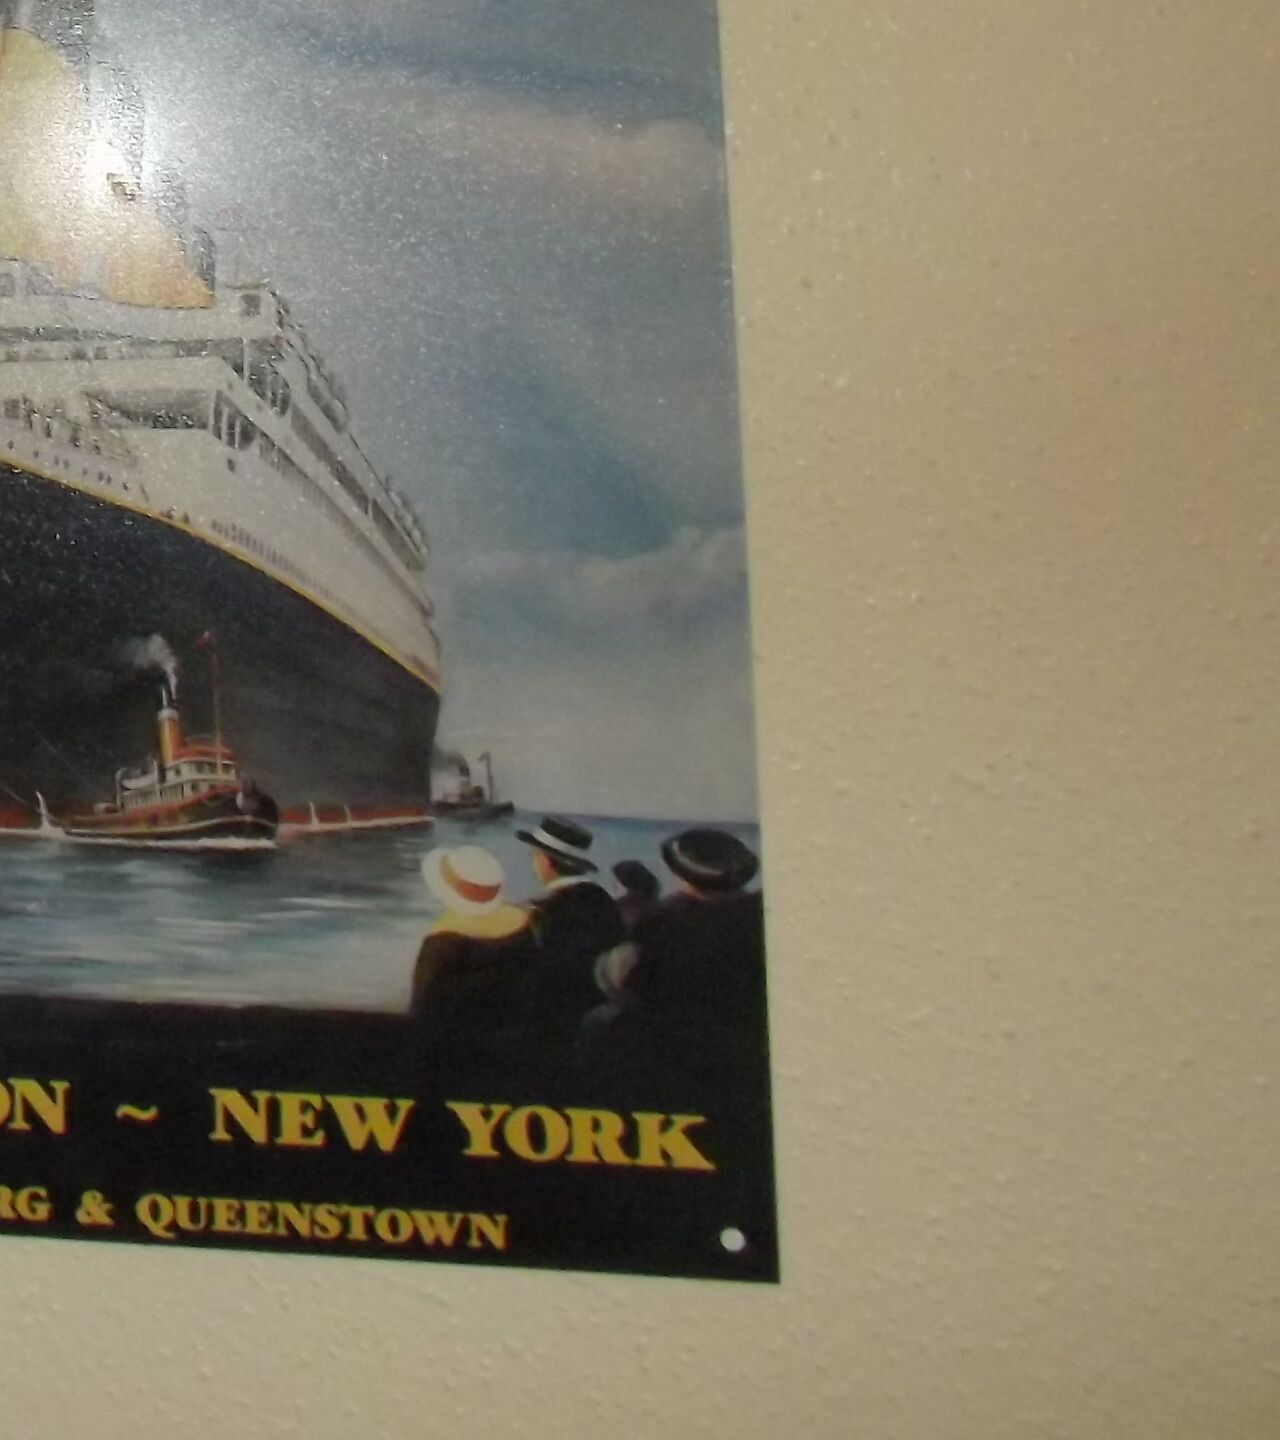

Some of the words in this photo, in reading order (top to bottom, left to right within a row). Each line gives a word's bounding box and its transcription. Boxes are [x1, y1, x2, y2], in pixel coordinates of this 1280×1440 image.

[208, 1086, 415, 1154] NEW
[446, 1099, 717, 1173] YORK
[75, 1190, 114, 1226] &
[136, 1193, 509, 1251] QUEENSTOWN
